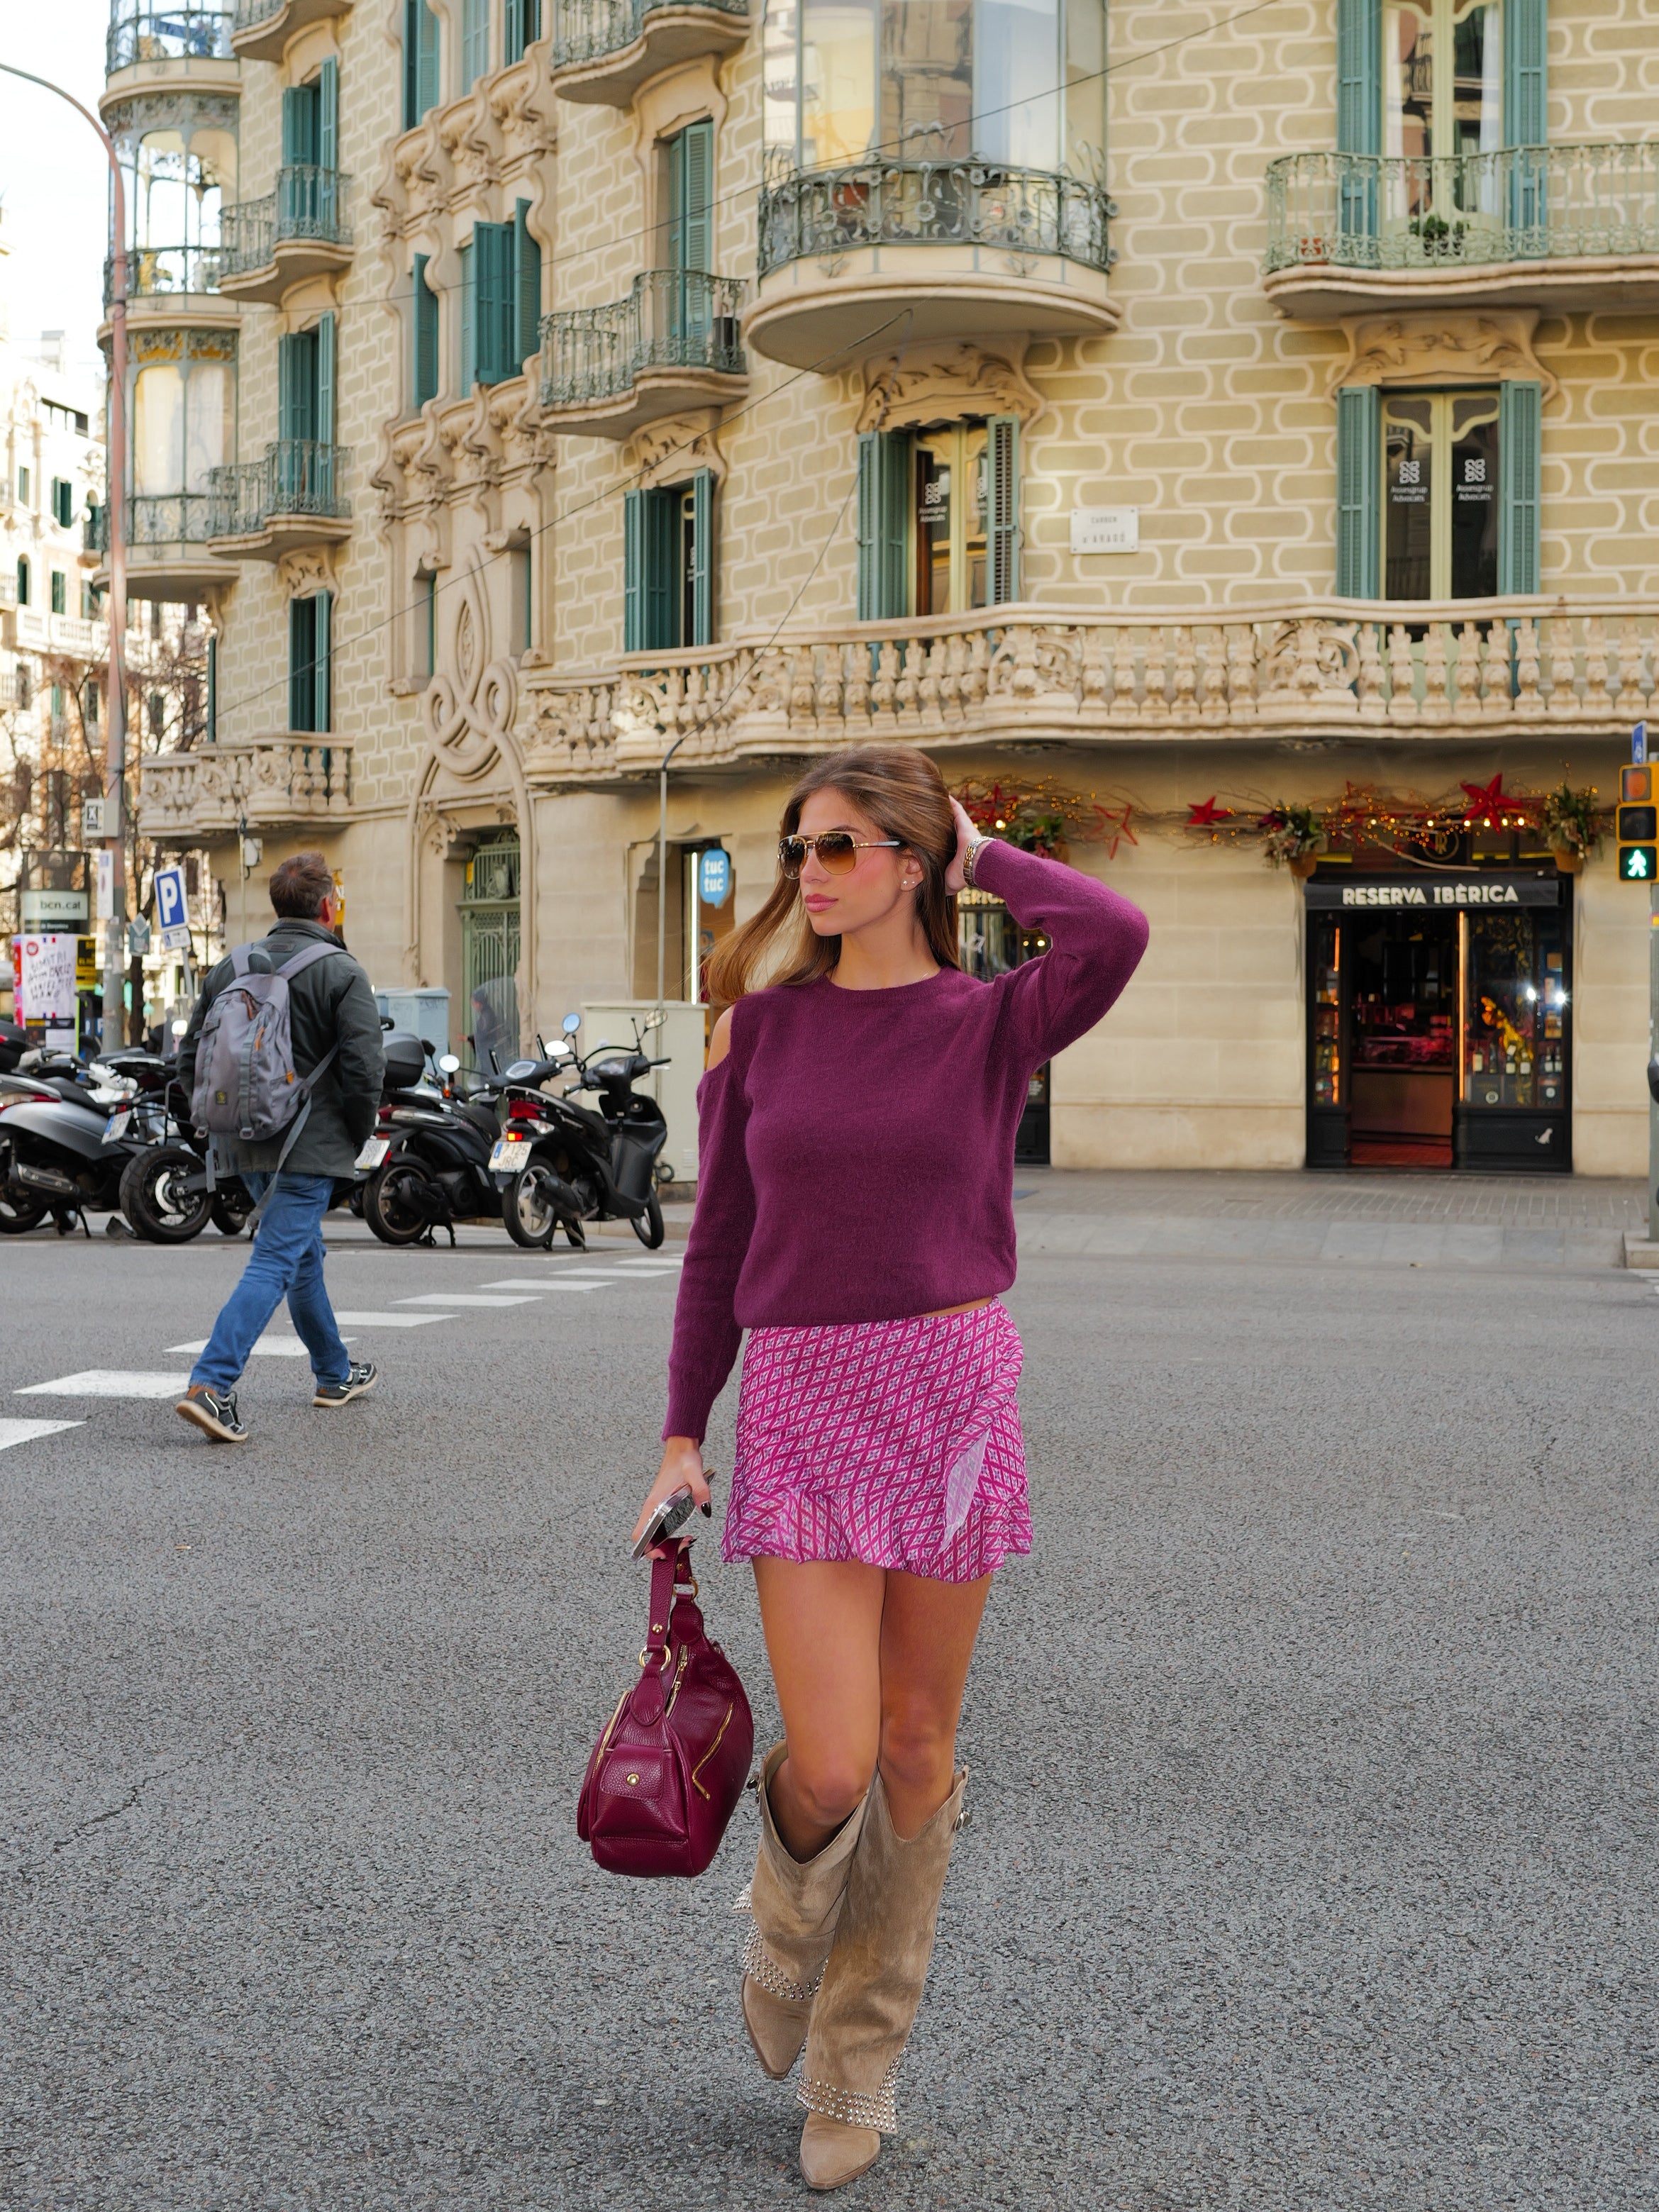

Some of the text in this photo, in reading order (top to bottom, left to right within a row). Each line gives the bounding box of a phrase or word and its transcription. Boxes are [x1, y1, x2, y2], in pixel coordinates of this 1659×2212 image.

[704, 860, 724, 875] tuc
[704, 877, 723, 892] tuc
[160, 876, 178, 925] P
[1343, 887, 1427, 906] RESERVA
[503, 1143, 528, 1156] 7125
